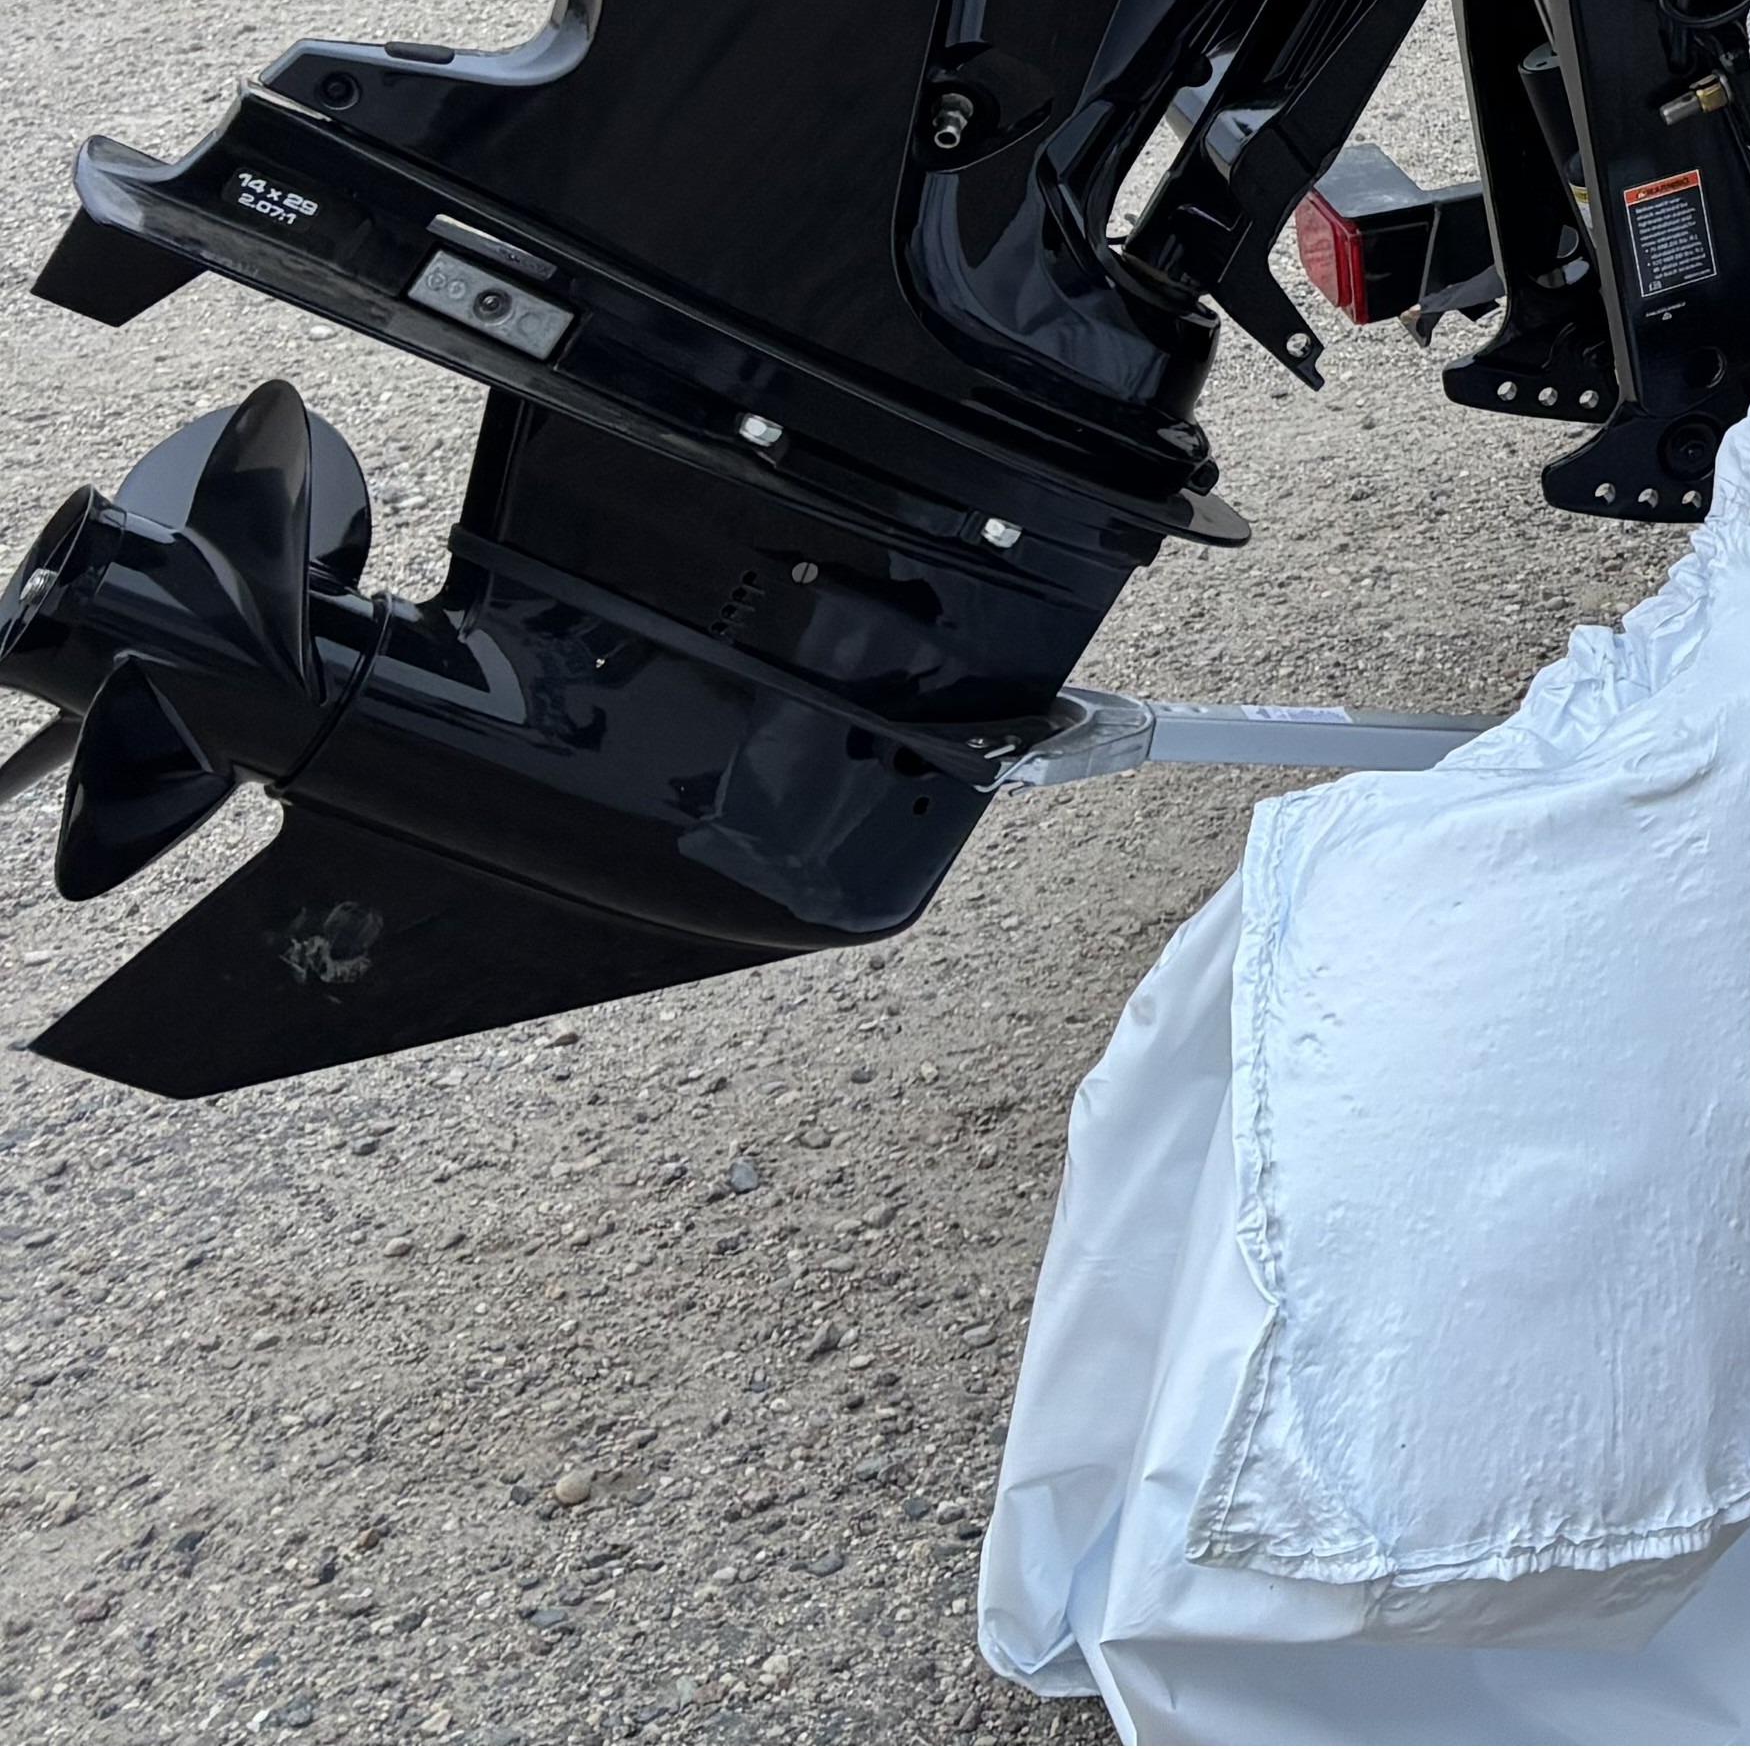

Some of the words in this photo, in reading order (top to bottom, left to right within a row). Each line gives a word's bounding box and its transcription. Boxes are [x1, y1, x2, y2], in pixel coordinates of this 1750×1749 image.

[238, 193, 297, 225] 2.07:1
[239, 173, 267, 193] 14
[266, 188, 282, 201] x
[283, 193, 318, 216] 29
